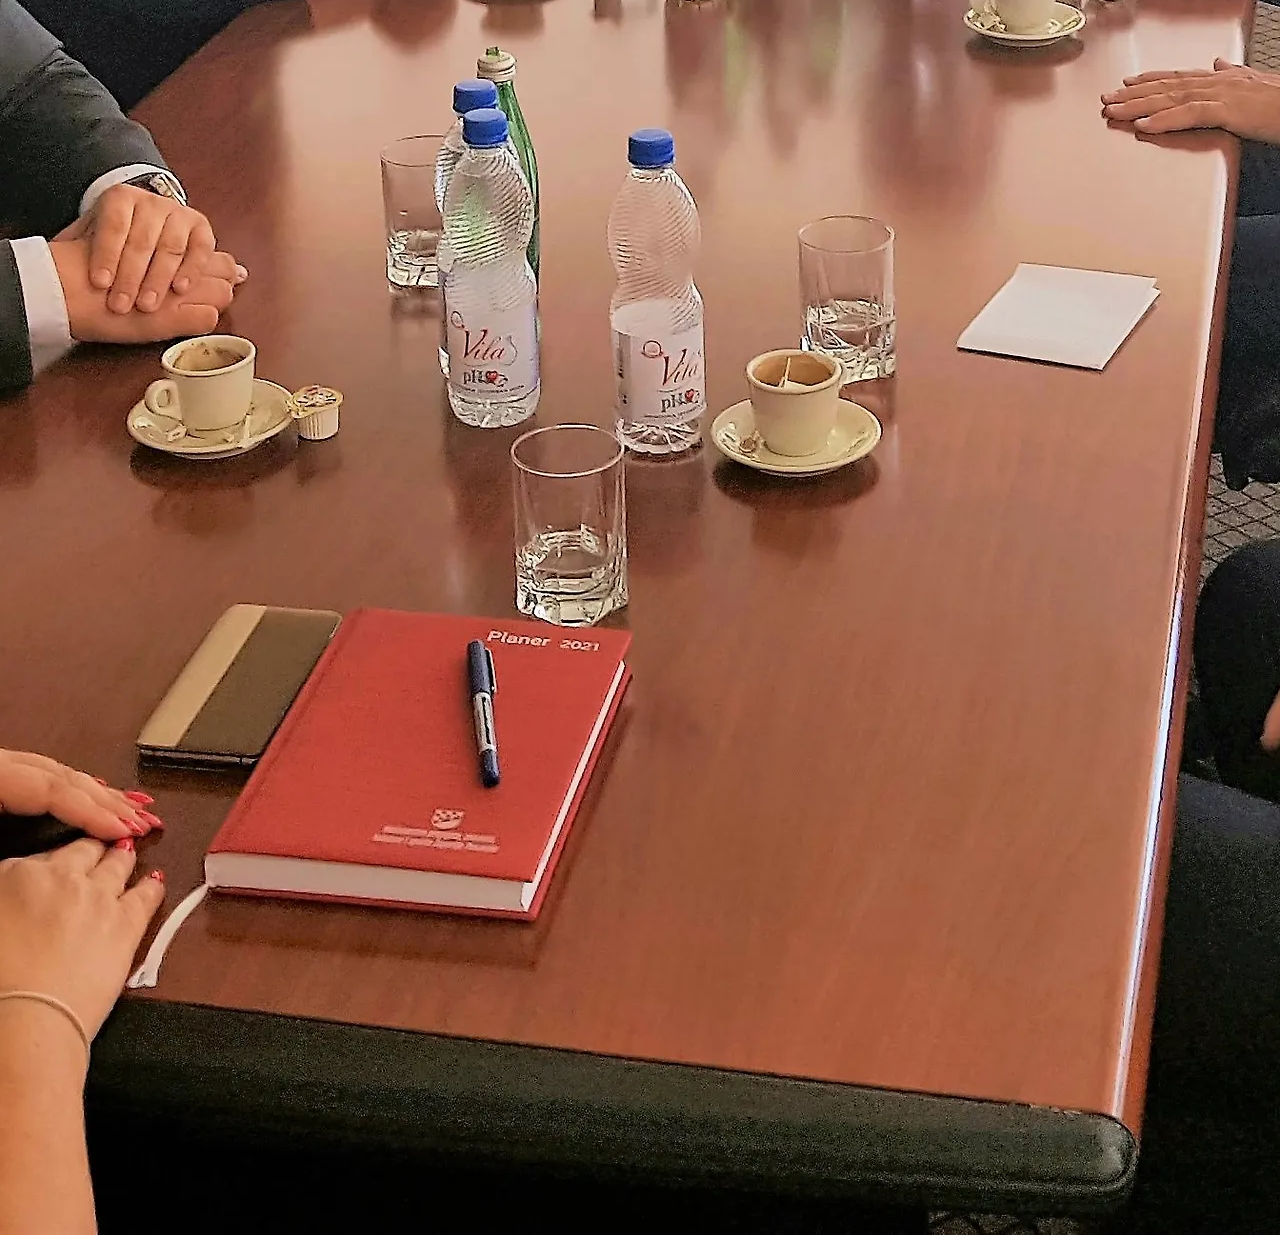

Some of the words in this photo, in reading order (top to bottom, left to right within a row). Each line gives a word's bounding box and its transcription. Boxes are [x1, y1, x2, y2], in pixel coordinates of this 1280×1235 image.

[462, 328, 505, 361] Vila
[486, 629, 552, 647] Planer
[560, 638, 600, 652] 2021
